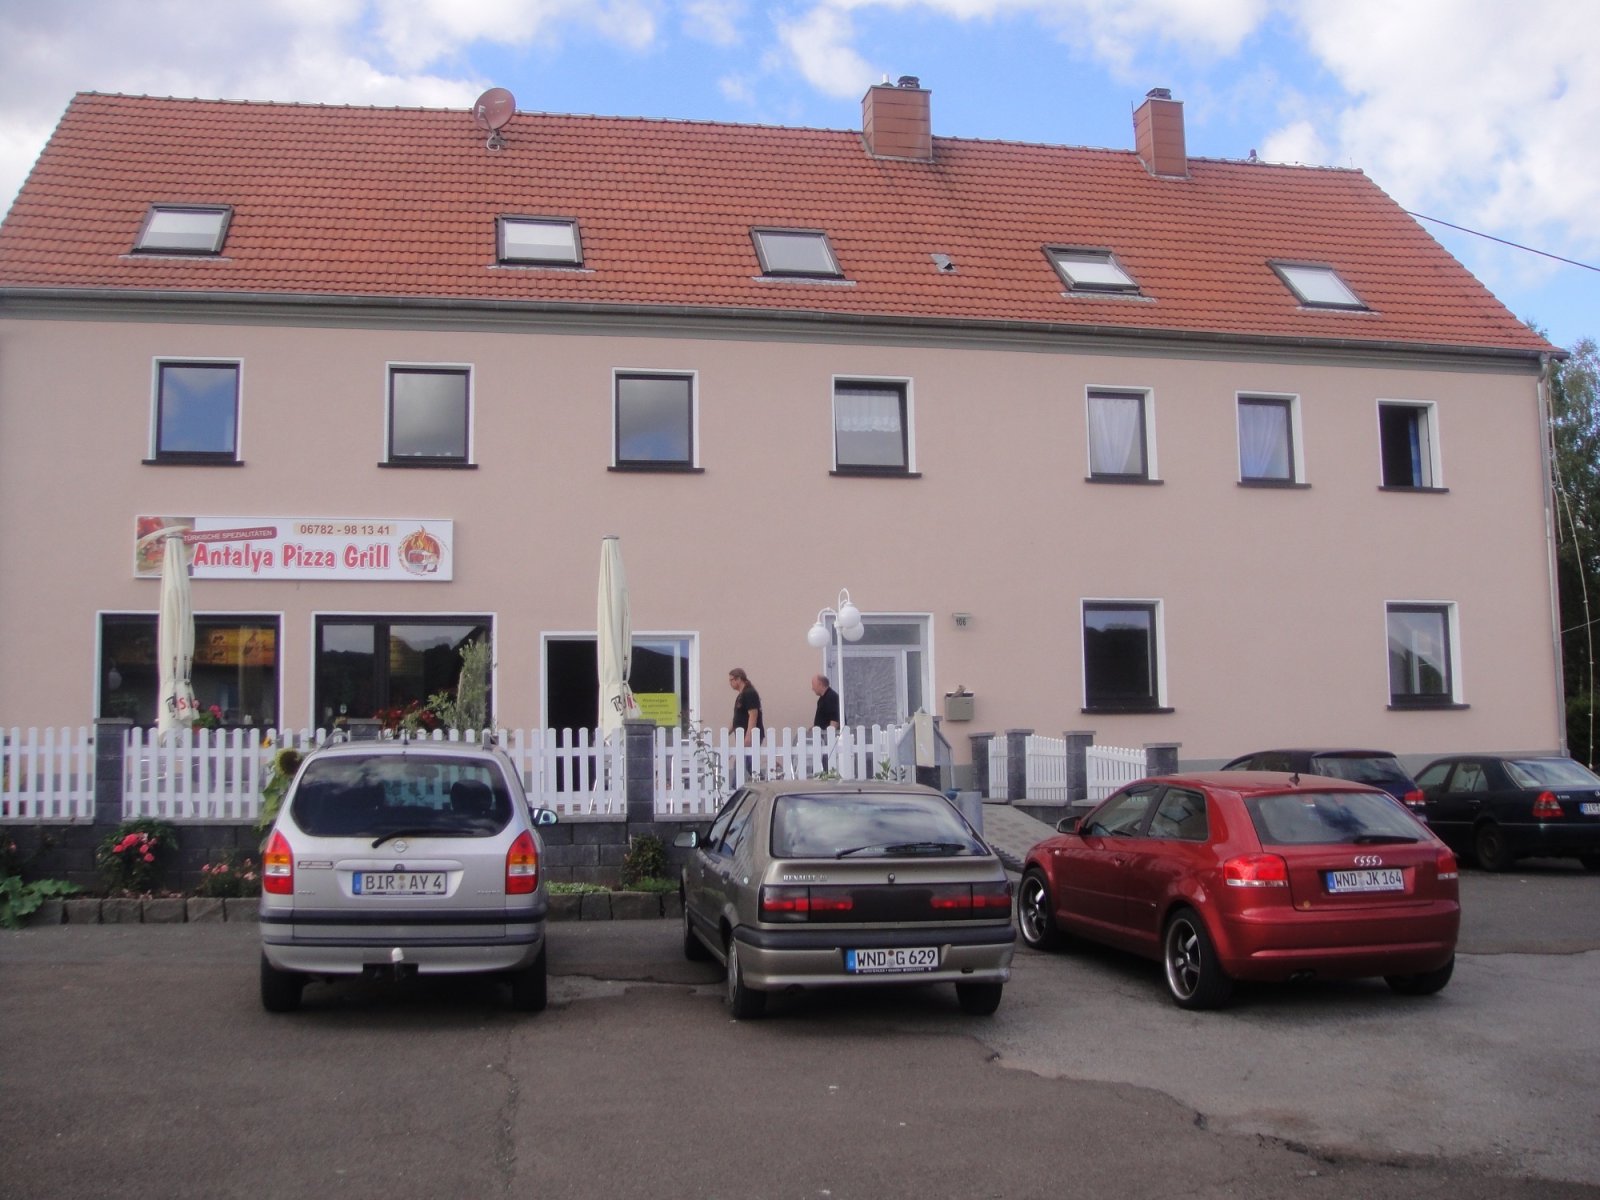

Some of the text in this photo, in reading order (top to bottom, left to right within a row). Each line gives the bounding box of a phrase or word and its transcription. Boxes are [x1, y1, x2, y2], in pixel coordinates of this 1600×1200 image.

[222, 529, 273, 539] SPEZIALITÄTEN
[300, 525, 334, 535] 06782
[344, 525, 358, 535] 98
[361, 525, 374, 535] 13
[377, 525, 390, 535] 41
[193, 543, 389, 572] Antalya Pizza Grill
[365, 875, 442, 890] BIR AY 4
[1334, 871, 1402, 887] WND JK 164
[857, 949, 936, 967] WND G 629
